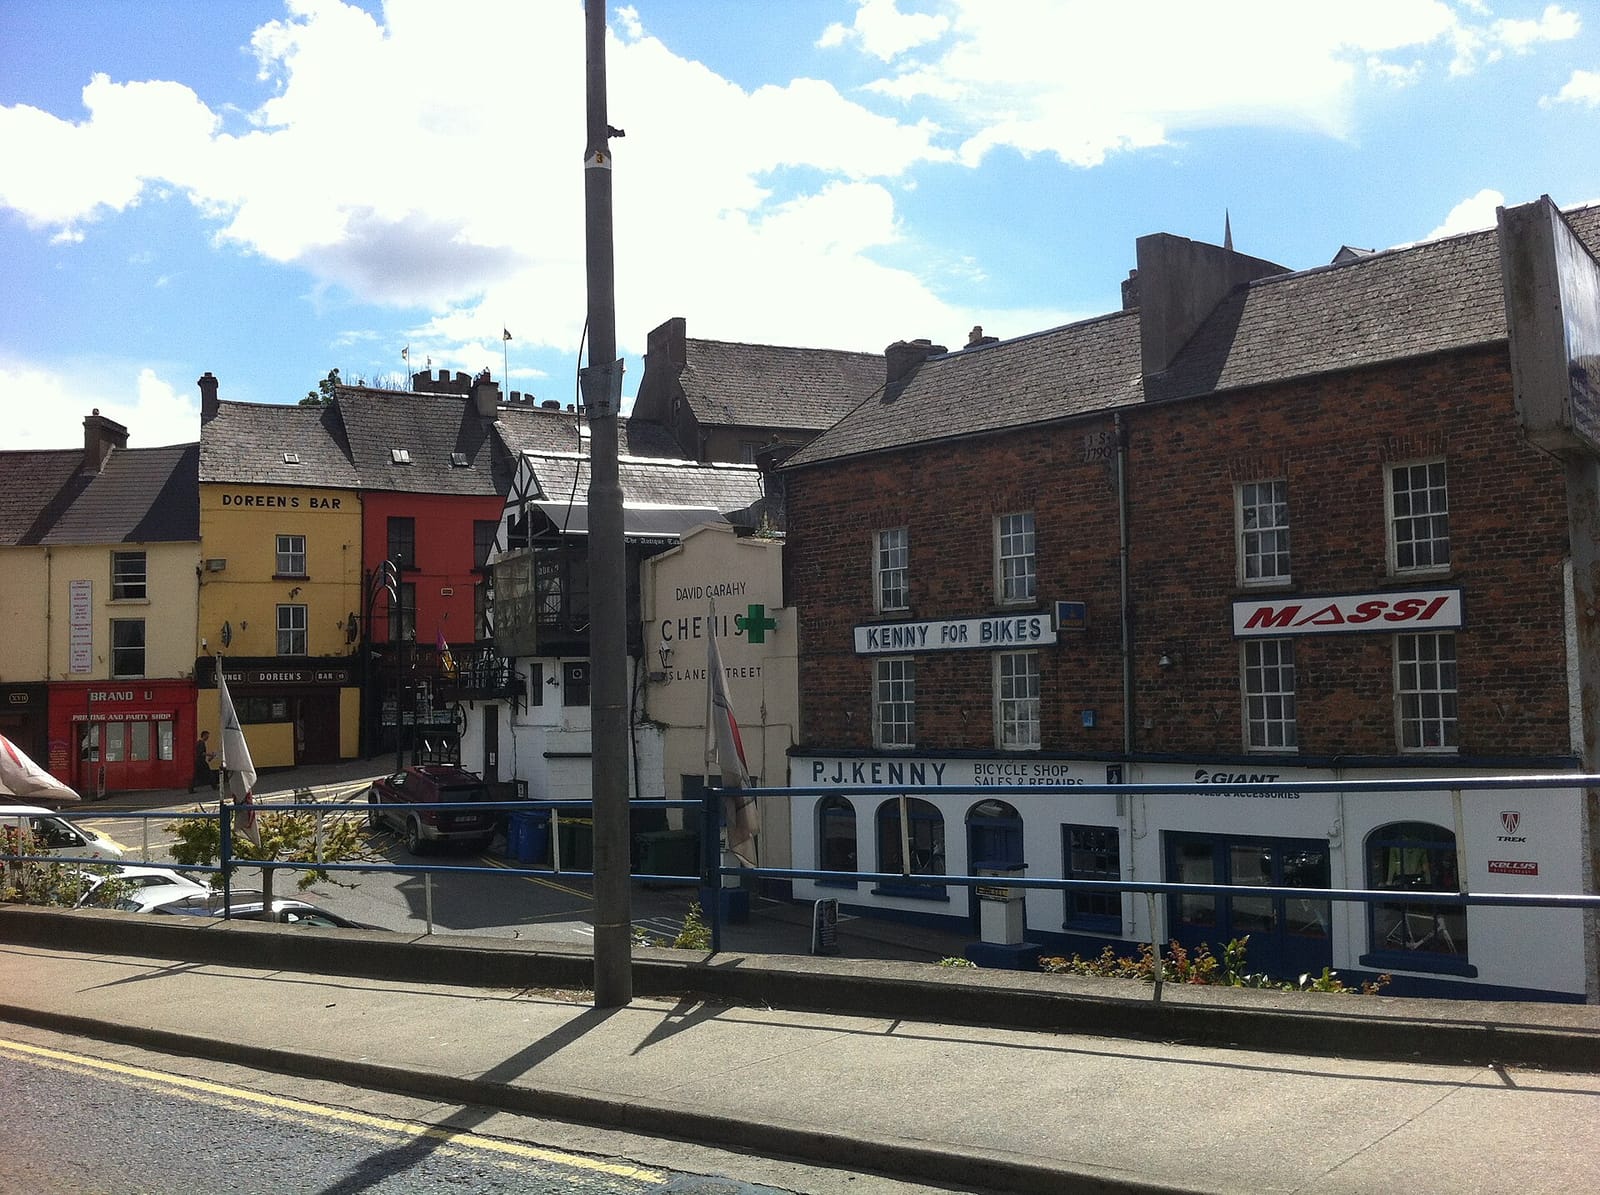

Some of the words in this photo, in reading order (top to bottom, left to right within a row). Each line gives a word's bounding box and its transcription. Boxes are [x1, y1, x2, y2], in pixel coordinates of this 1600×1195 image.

[222, 494, 299, 508] DOREEN'S
[309, 497, 341, 509] BAR
[675, 586, 703, 601] DAVID
[705, 582, 746, 597] GARAHY
[1243, 596, 1450, 629] MASSI
[866, 625, 929, 650] KENNY
[941, 624, 968, 644] FOR
[980, 617, 1042, 644] BIKES
[259, 673, 302, 681] DOREEN'S
[668, 669, 707, 681] SLANE
[725, 667, 761, 679] TREET
[90, 691, 134, 701] BRAND
[144, 690, 153, 700] U
[974, 763, 1028, 776] BICYCLE
[1033, 765, 1069, 777] SHOP
[1211, 772, 1280, 784] GIANT
[1496, 835, 1527, 843] TREK
